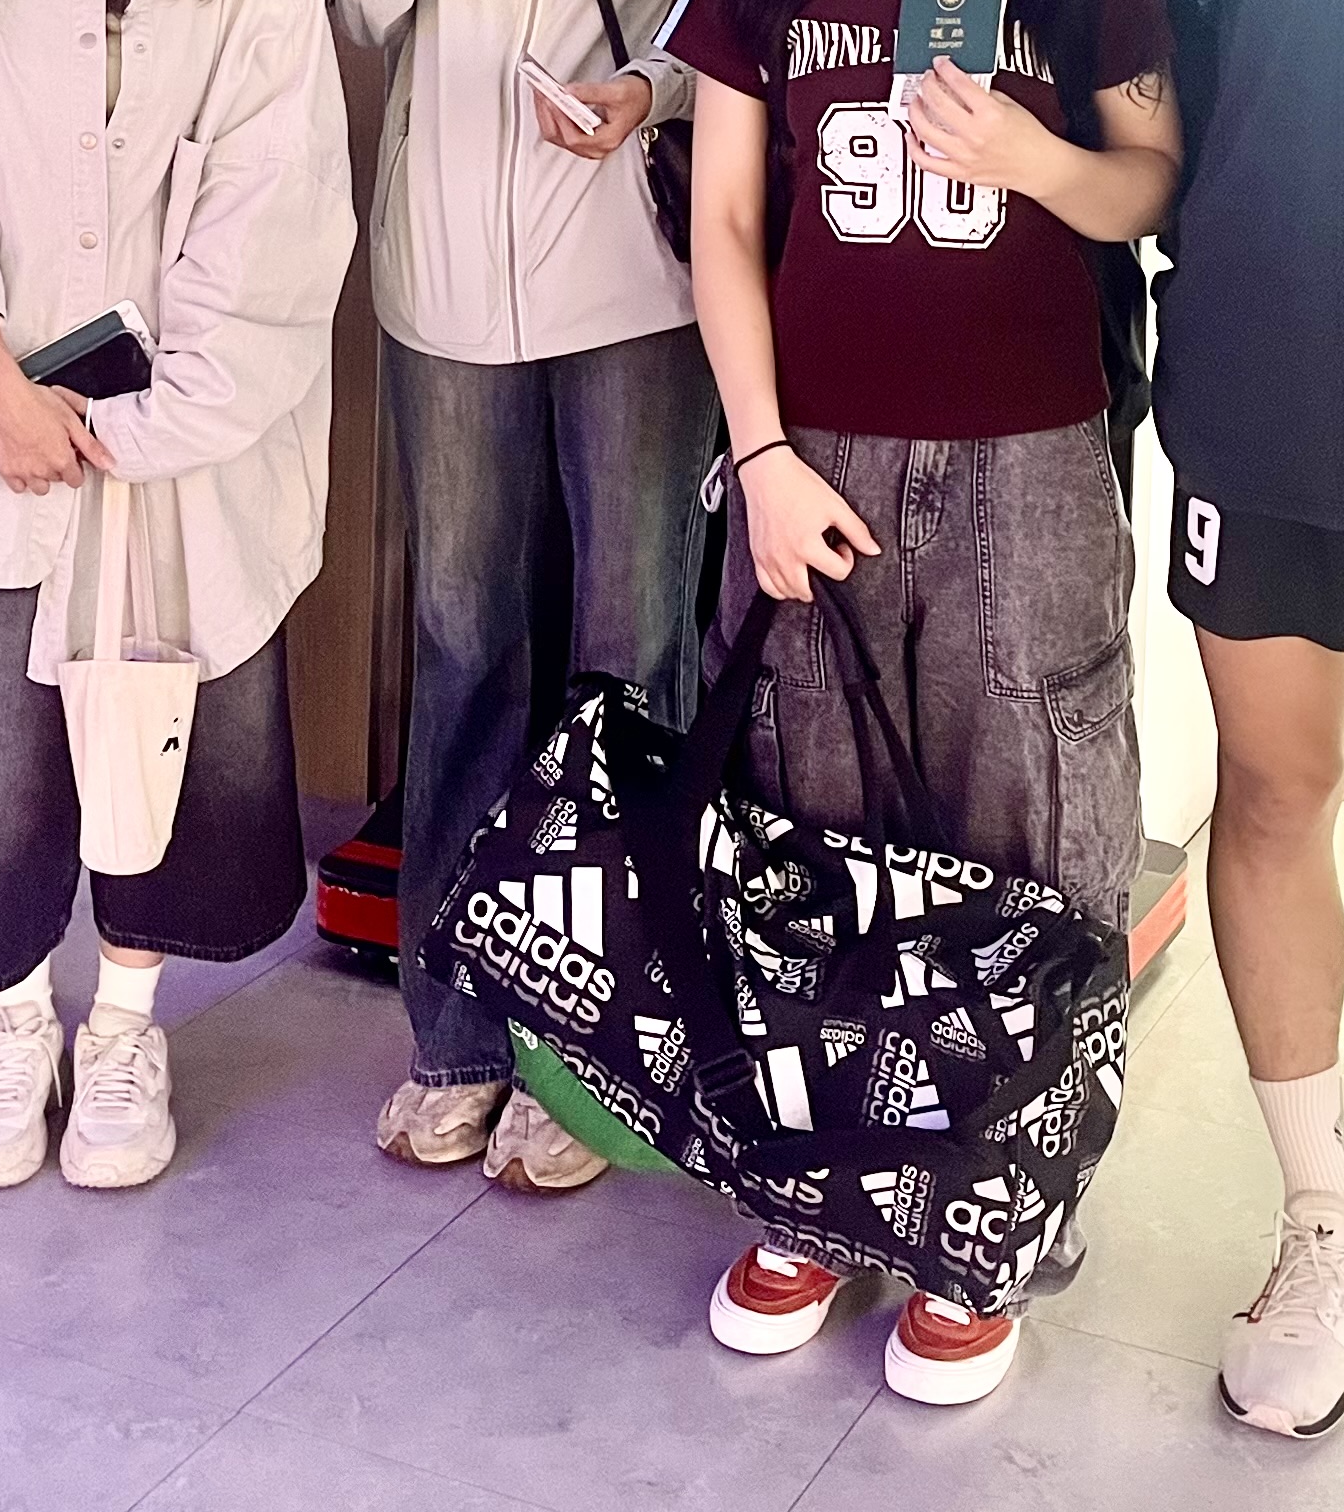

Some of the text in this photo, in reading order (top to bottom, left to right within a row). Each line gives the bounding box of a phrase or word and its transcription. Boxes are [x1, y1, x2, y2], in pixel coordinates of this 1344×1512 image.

[1184, 496, 1221, 586] 9
[535, 800, 577, 856] adidas
[467, 891, 616, 1002] adidas
[983, 922, 1040, 987] adidas
[931, 1021, 987, 1052] adidas
[882, 1038, 917, 1126] adida
[893, 1164, 918, 1238] adidas
